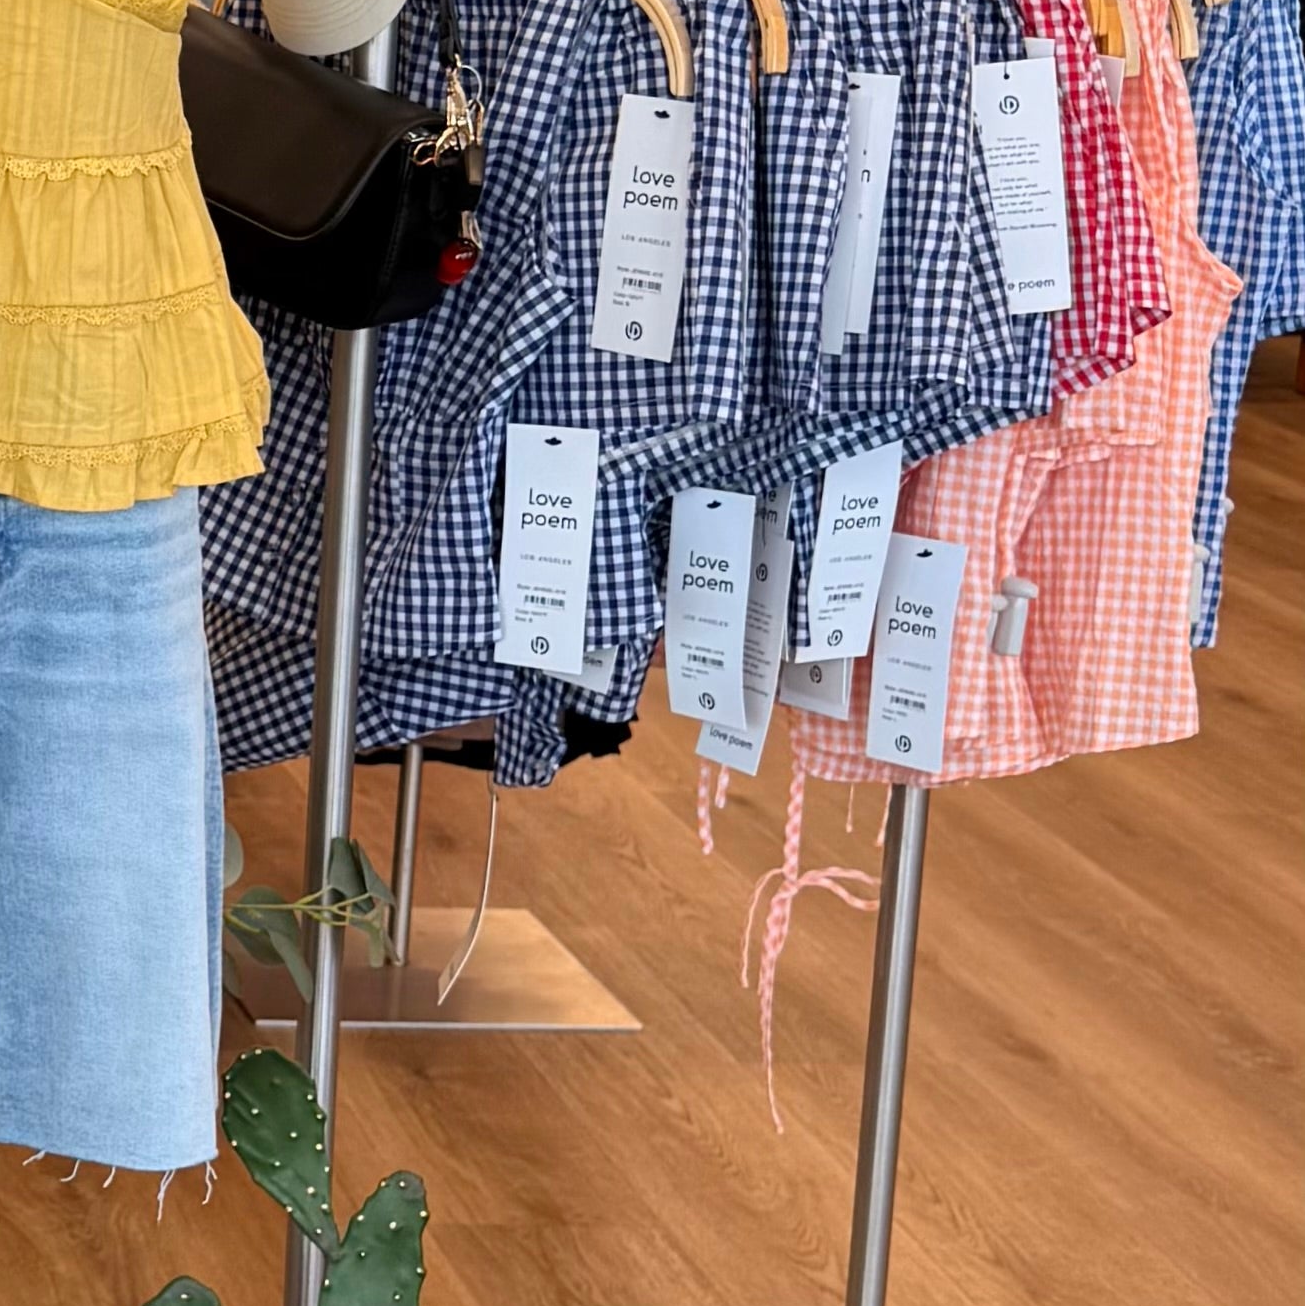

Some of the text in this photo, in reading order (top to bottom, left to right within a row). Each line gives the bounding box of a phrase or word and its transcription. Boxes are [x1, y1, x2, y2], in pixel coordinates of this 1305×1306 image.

[622, 190, 679, 211] poem
[1018, 278, 1055, 293] poem
[520, 511, 578, 531] poem
[832, 514, 881, 535] poem
[682, 572, 734, 594] poem
[888, 618, 937, 640] poem
